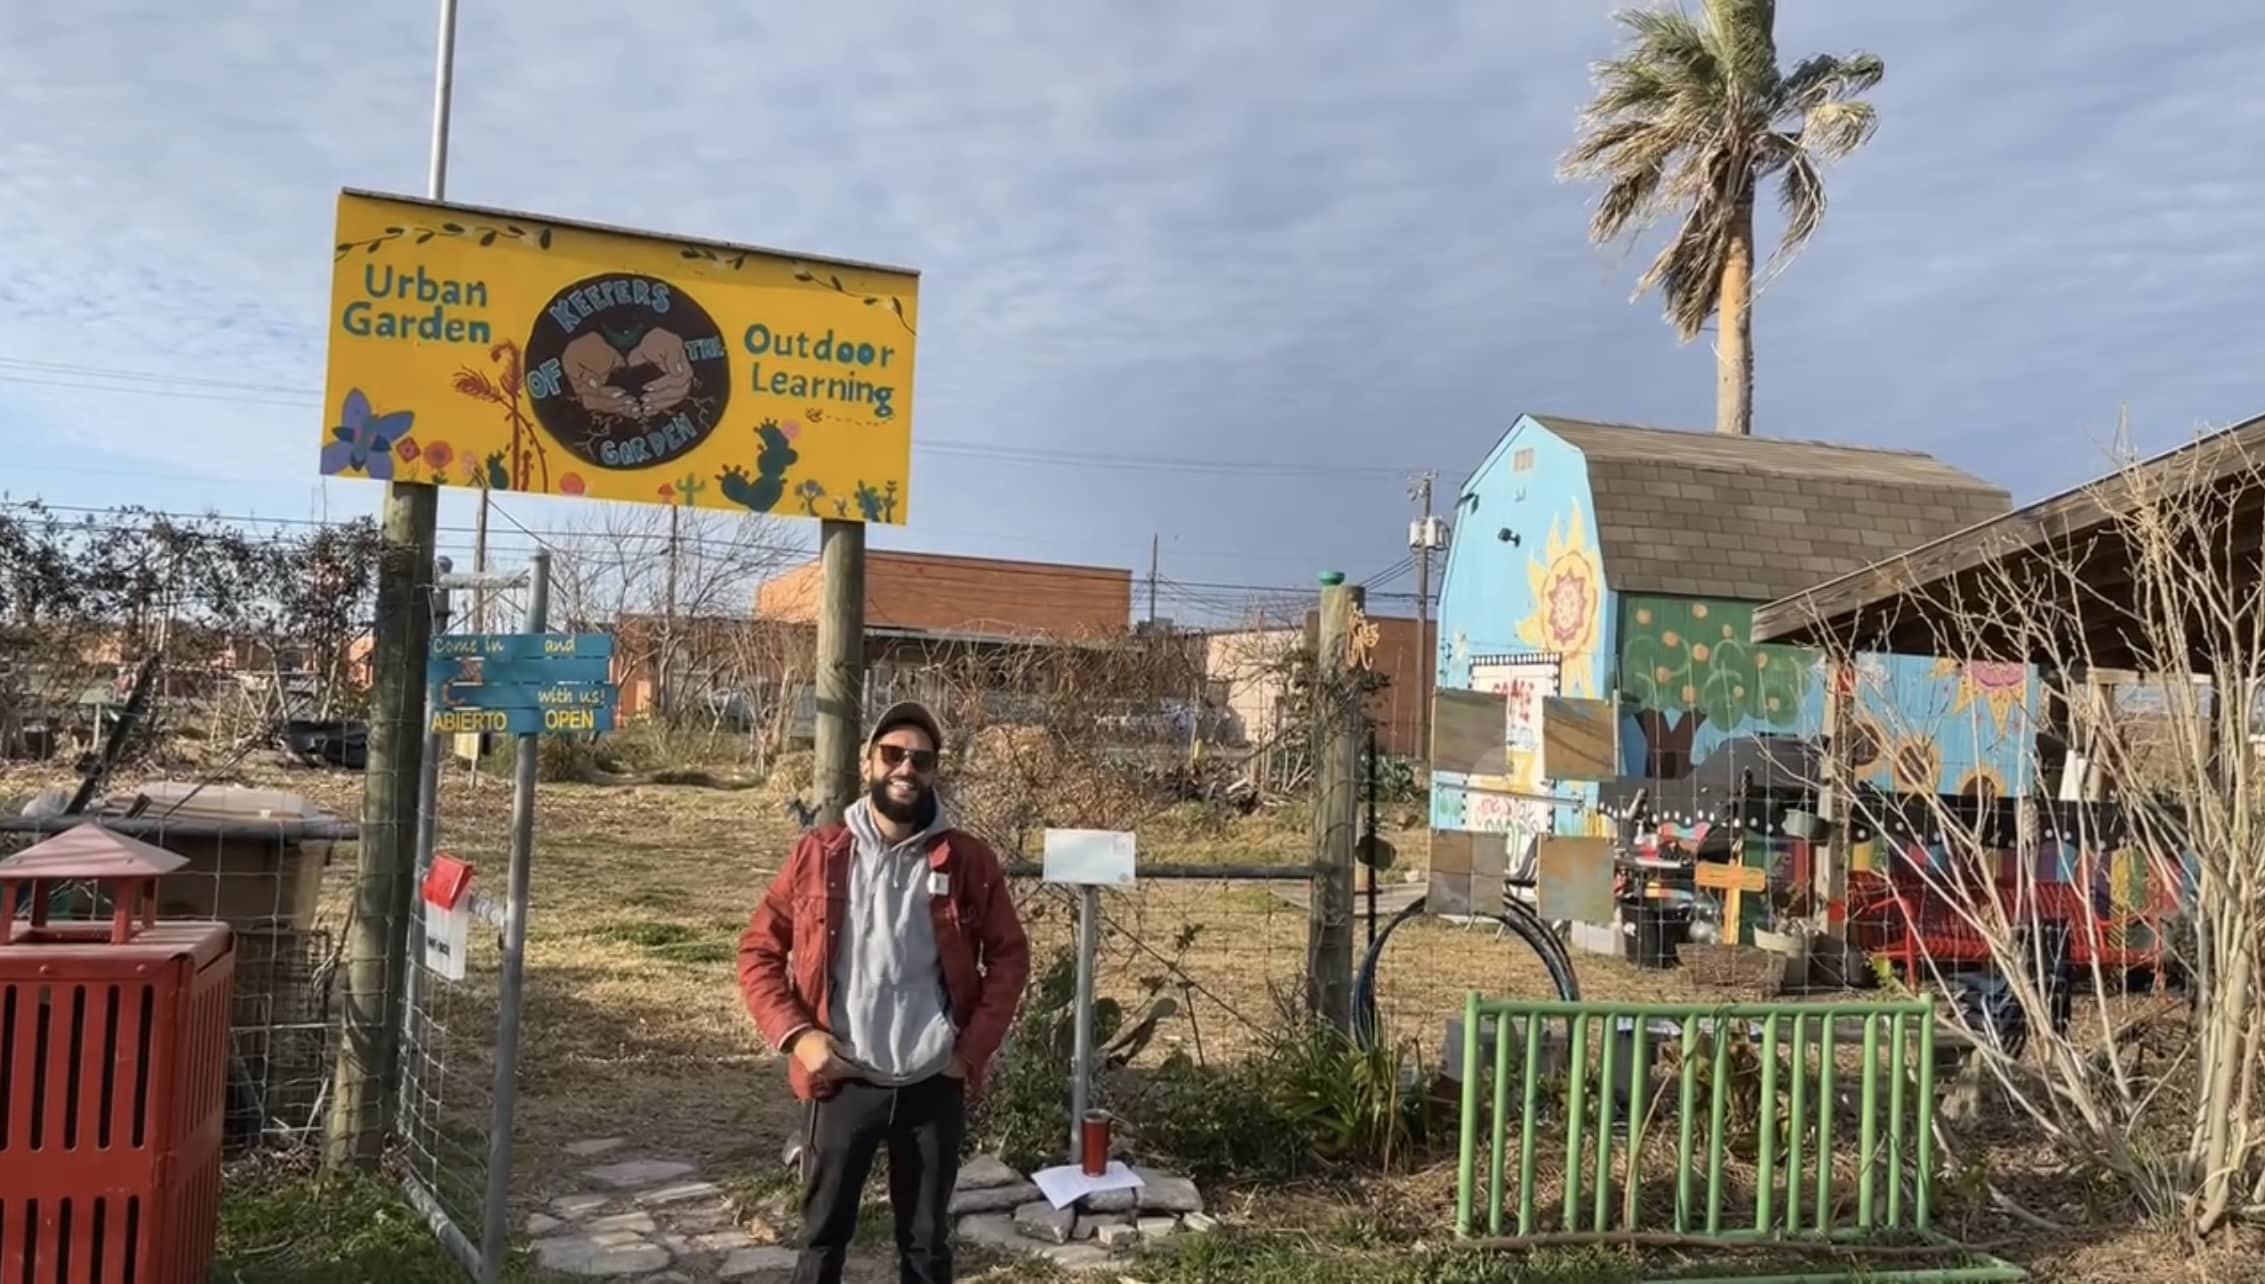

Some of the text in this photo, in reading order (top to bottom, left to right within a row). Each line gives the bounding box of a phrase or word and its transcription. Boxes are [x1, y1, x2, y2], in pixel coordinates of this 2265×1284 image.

[365, 263, 488, 307] Urban
[549, 279, 671, 333] KEEPERS
[342, 301, 491, 343] Garden
[744, 323, 895, 367] Outdoor
[527, 357, 562, 399] OF
[752, 362, 895, 418] Learning
[601, 411, 697, 465] GARDEN
[433, 638, 478, 653] Come
[544, 636, 576, 653] and
[537, 686, 573, 704] with
[431, 710, 595, 730] ABIERTO OPEN
